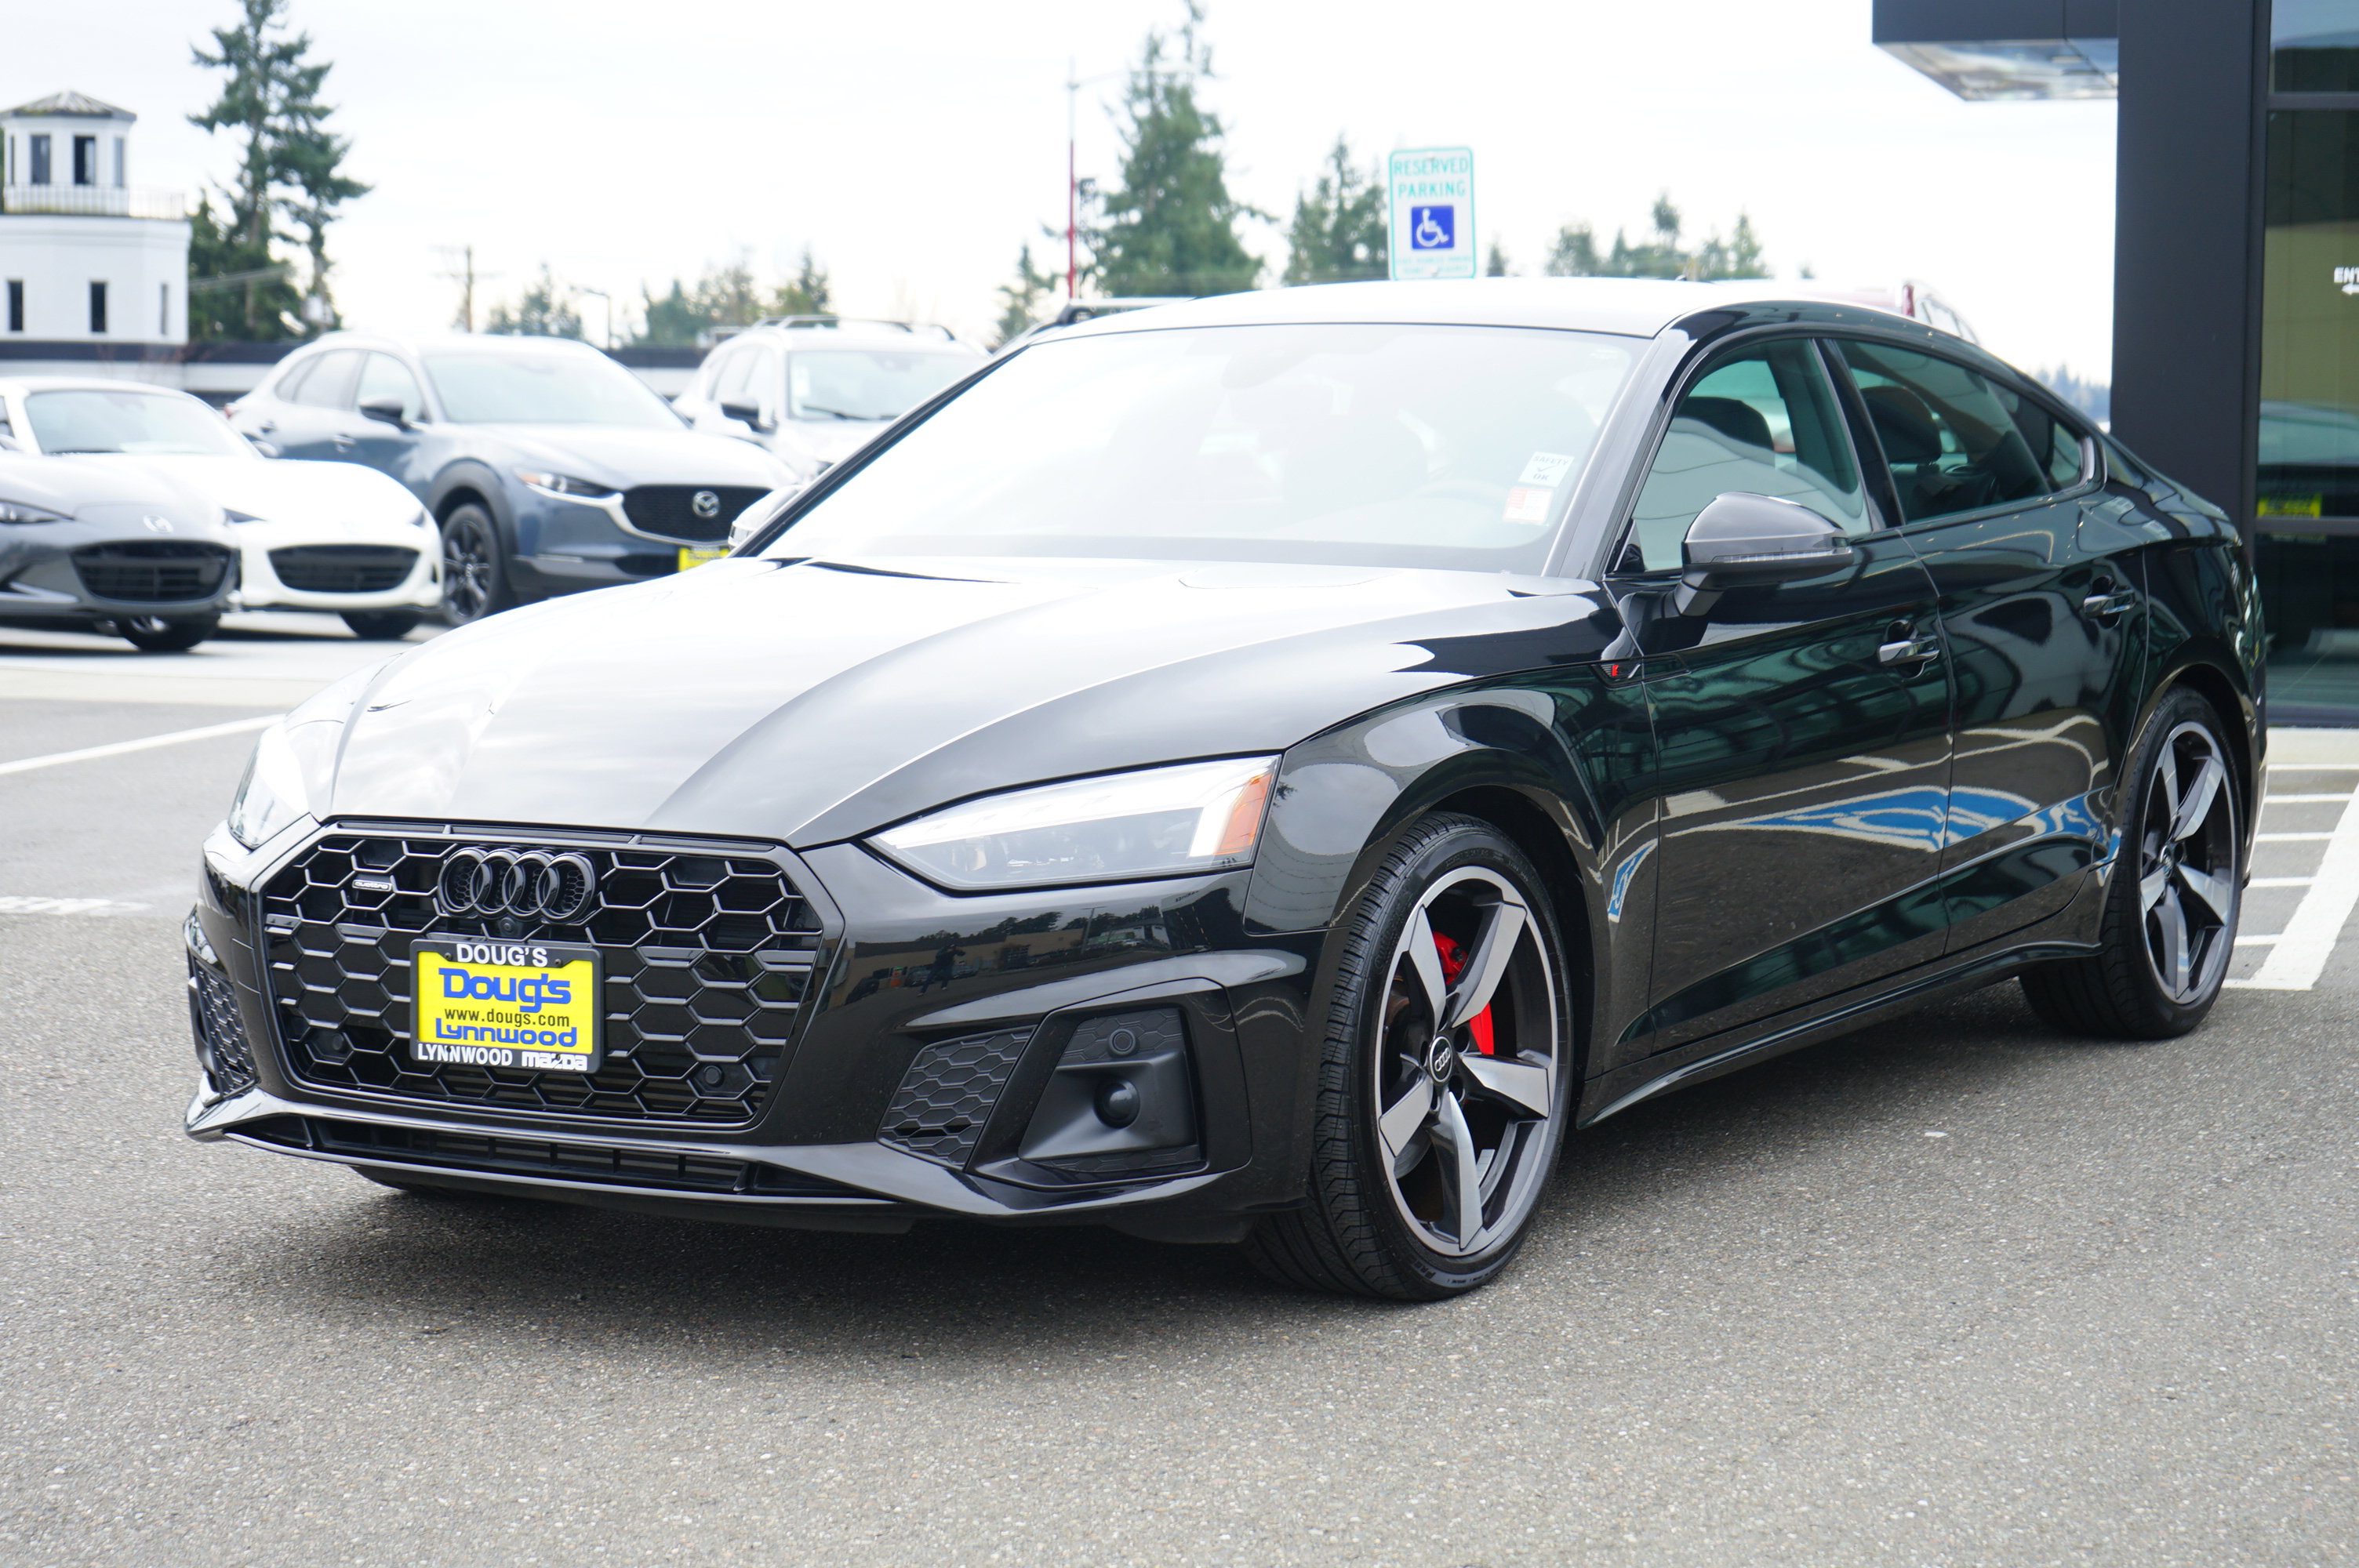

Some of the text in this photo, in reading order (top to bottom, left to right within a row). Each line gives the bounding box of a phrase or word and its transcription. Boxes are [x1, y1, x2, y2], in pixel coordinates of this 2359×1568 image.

[1394, 158, 1468, 176] RESERVED
[1398, 181, 1466, 198] PARKING
[1533, 456, 1568, 466] SAFETY
[456, 943, 547, 967] DOUG'S
[445, 1008, 569, 1027] www.dougs.com
[435, 1018, 577, 1047] Lynnwood
[418, 1043, 513, 1066] LYNNWOOD
